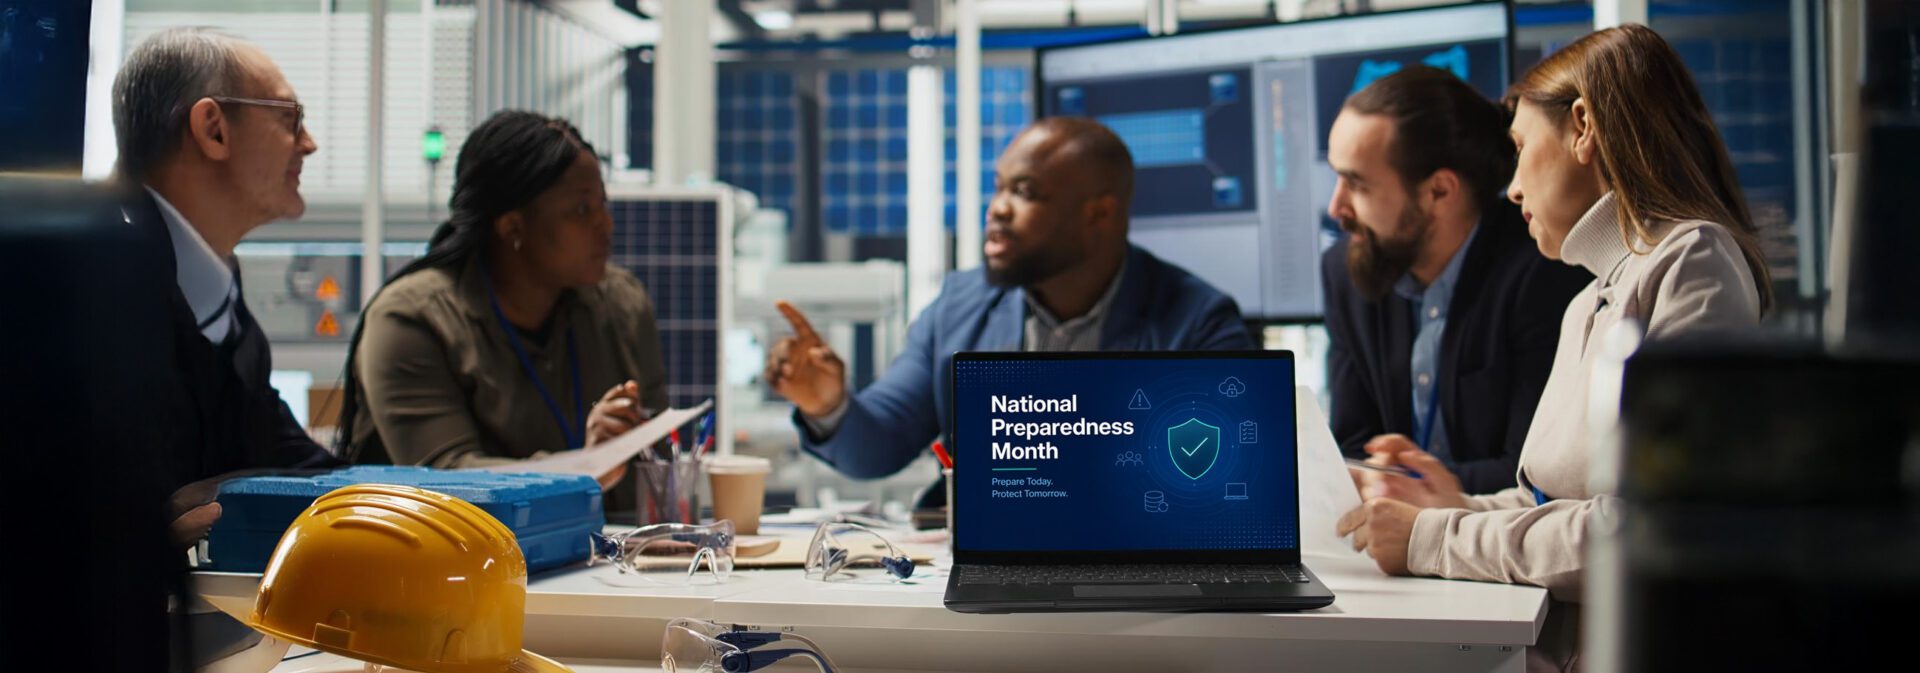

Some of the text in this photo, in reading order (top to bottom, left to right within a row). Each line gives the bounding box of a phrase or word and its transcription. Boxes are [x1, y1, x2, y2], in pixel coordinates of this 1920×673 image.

[991, 394, 1077, 413] National
[991, 417, 1135, 441] Preparedness
[991, 441, 1059, 460] Month
[991, 476, 1054, 487] Prepare Today.
[991, 489, 1069, 498] Protect Tomorrow.
